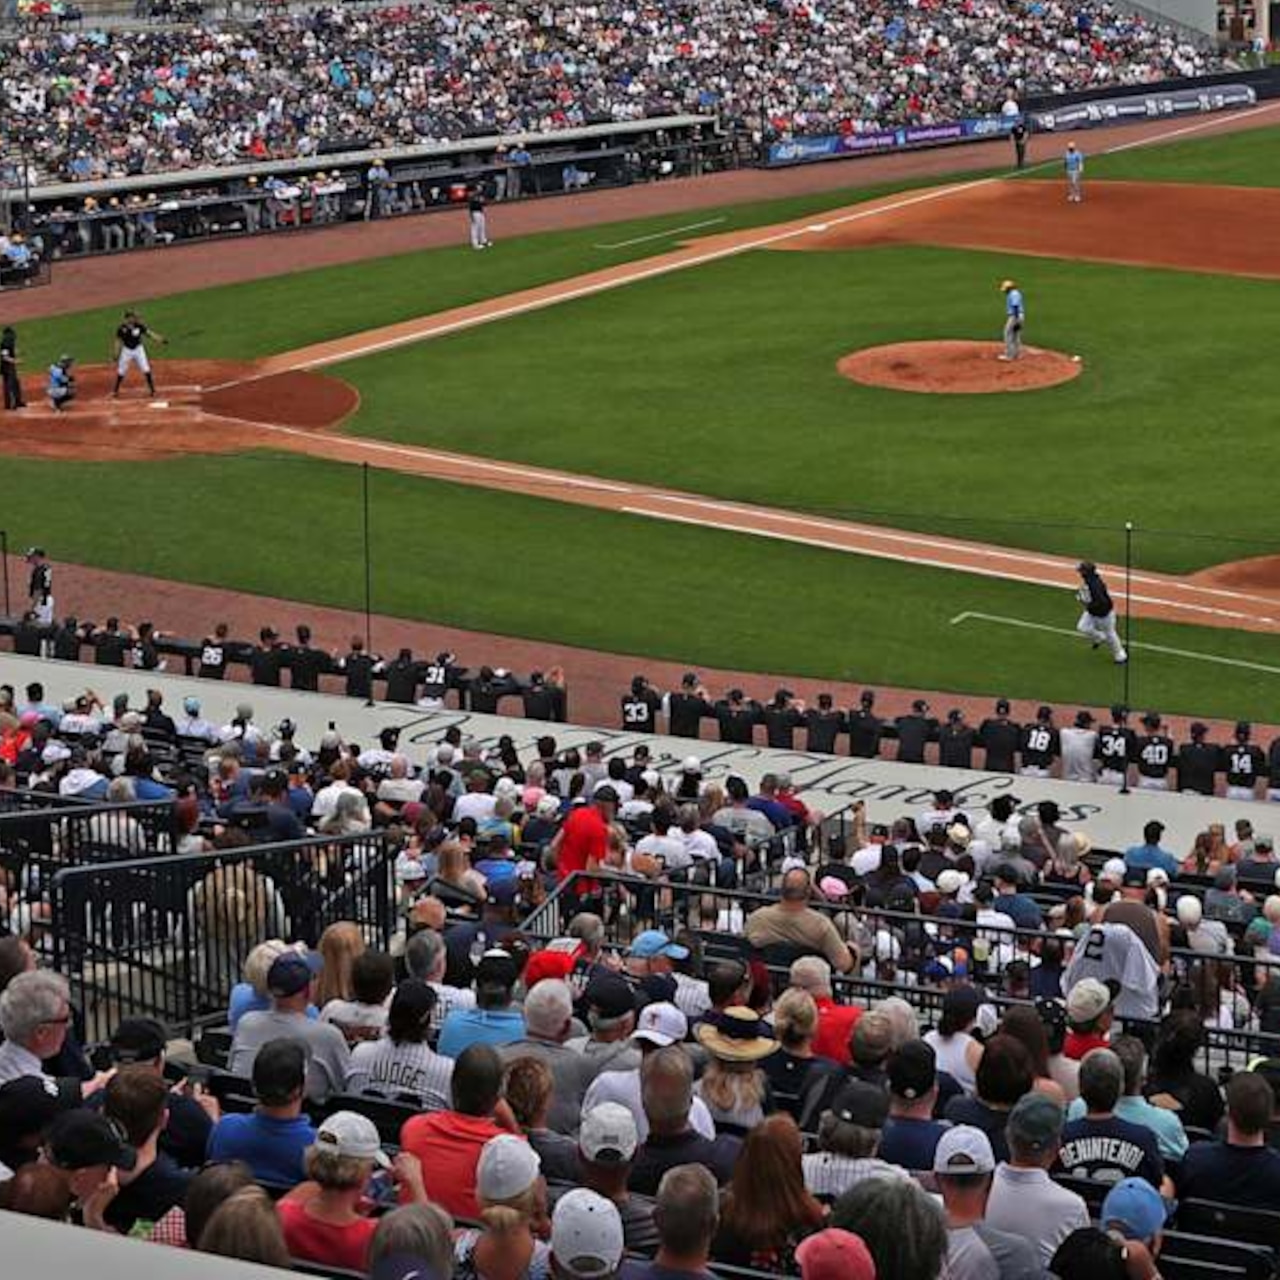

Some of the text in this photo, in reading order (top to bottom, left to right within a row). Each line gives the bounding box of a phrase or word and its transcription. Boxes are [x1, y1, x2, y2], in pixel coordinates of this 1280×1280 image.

[201, 646, 224, 666] 26
[425, 666, 446, 685] 31
[623, 702, 648, 723] 33
[1027, 728, 1050, 751] 18
[1101, 734, 1126, 757] 34
[1141, 744, 1169, 766] 40
[1231, 753, 1253, 774] 14
[1084, 930, 1105, 960] 2
[368, 1058, 426, 1089] JUDGE
[1056, 1136, 1145, 1172] BENINTENDI
